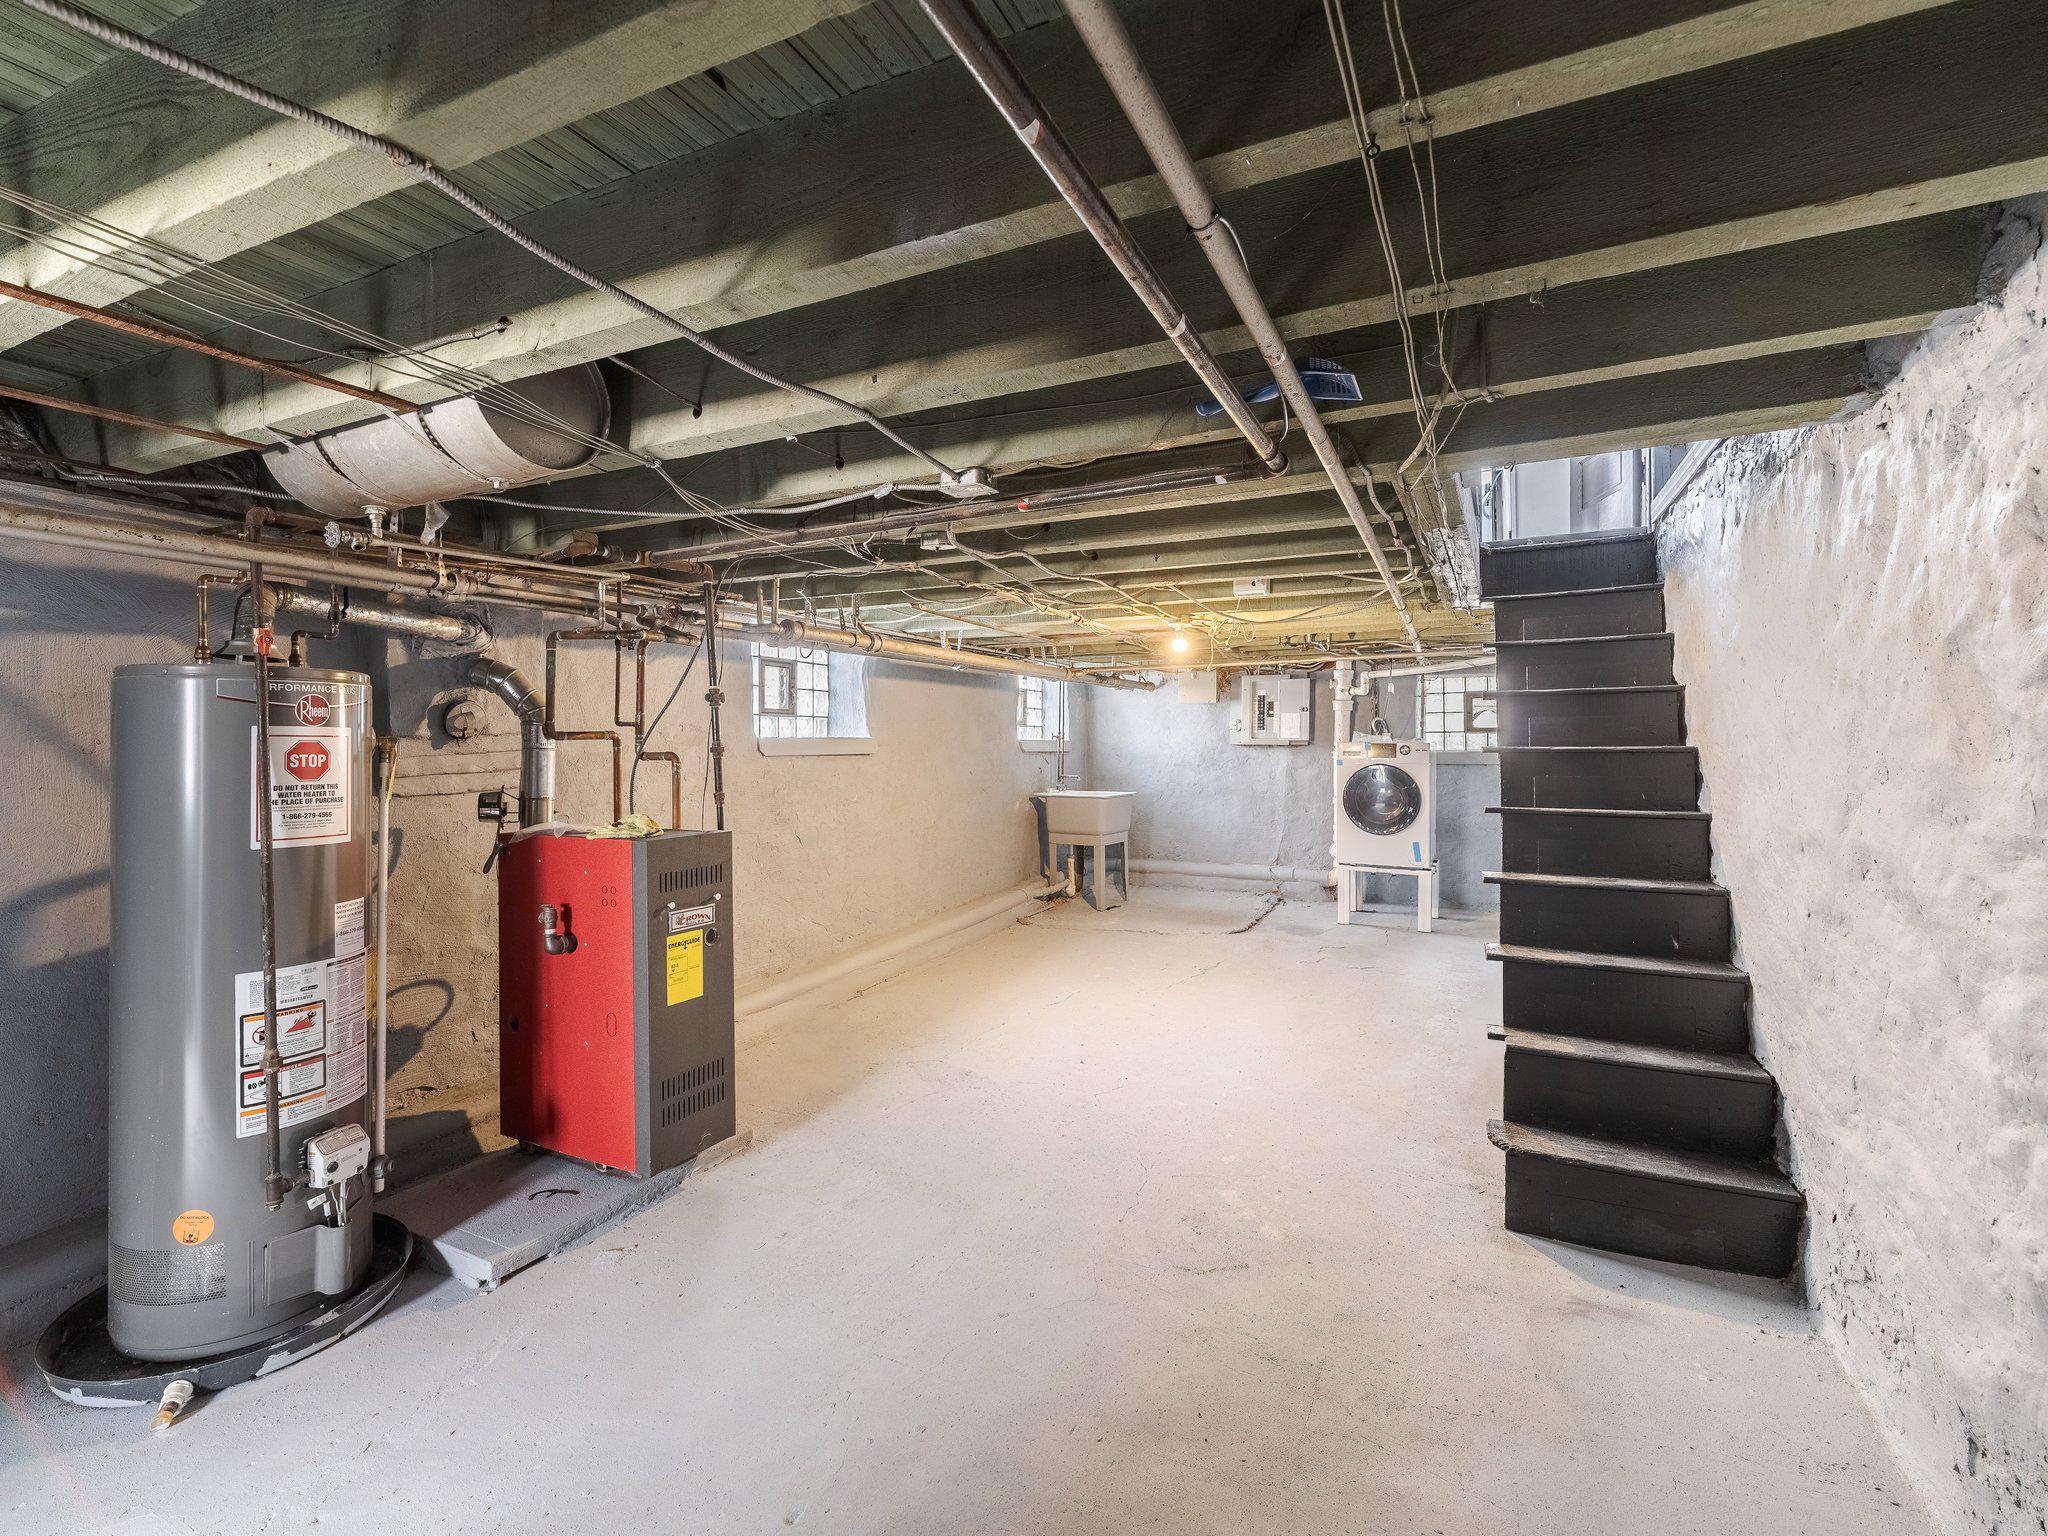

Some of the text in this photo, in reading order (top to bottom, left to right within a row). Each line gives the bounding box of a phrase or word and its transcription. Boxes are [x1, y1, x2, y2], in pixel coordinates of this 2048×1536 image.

[269, 683, 337, 694] RFORMANCE
[300, 695, 329, 721] Rheem
[289, 753, 327, 768] STOP
[277, 791, 302, 799] WATER
[281, 798, 303, 806] PLACE
[315, 796, 343, 804] PURCHASE
